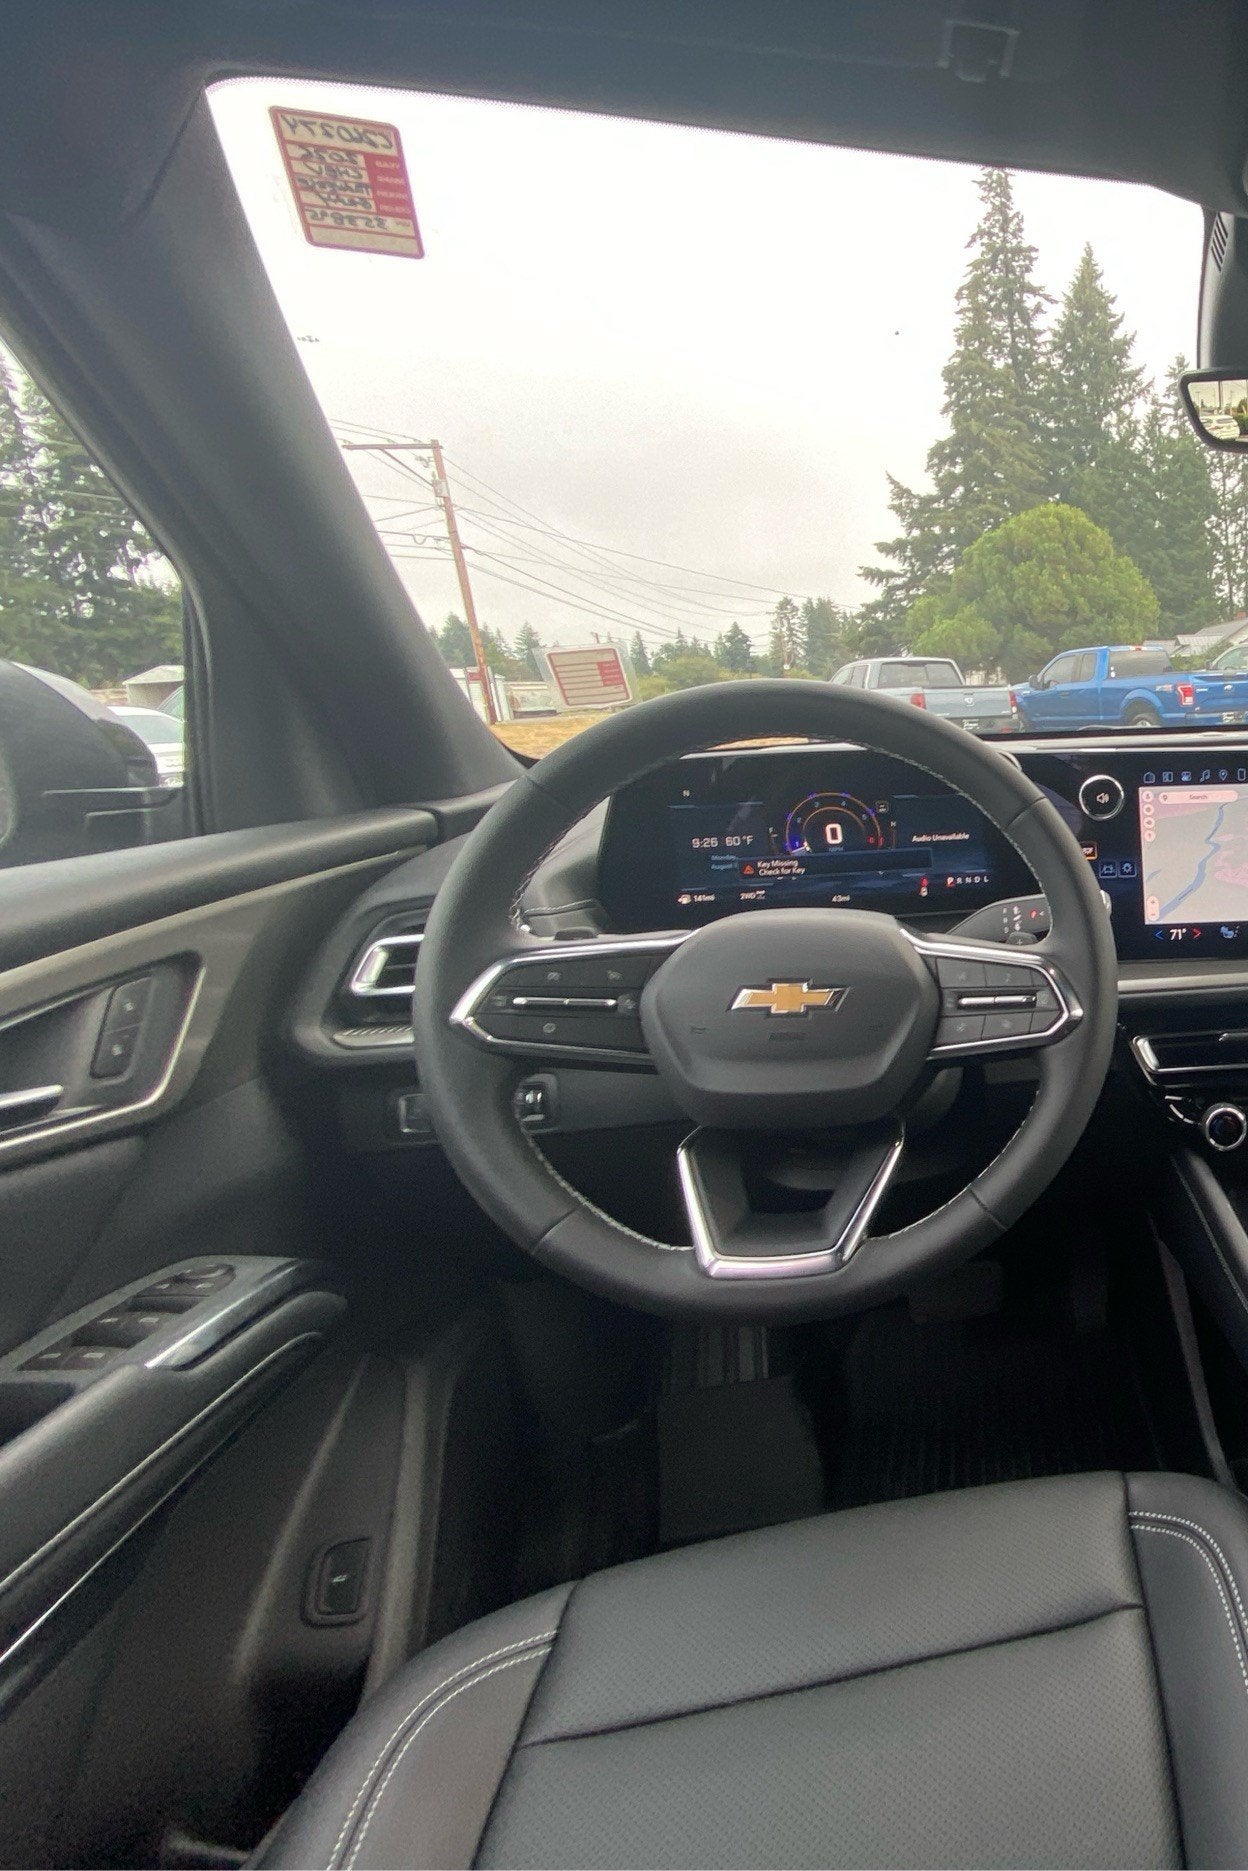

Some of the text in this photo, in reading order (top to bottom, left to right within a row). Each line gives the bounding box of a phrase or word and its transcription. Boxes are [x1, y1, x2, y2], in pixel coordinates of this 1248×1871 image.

[825, 823, 843, 844] 0
[912, 832, 970, 842] Audio Unavailable
[757, 860, 799, 869] Key Missing
[758, 868, 780, 876] Check
[792, 867, 805, 875] Key
[1169, 928, 1187, 940] 71°
